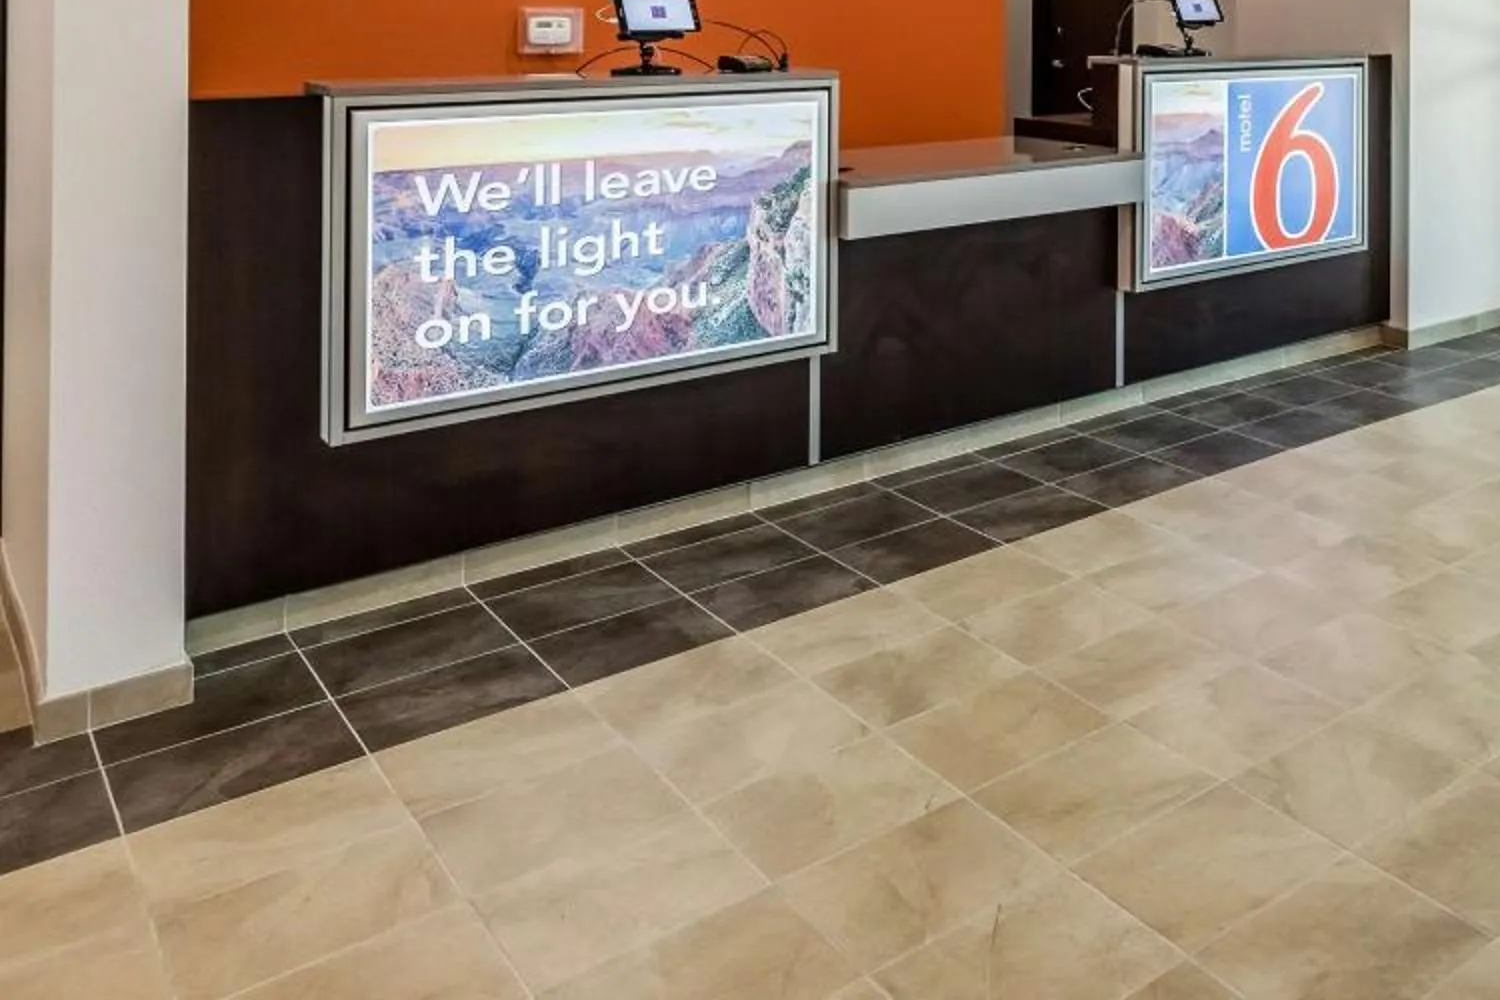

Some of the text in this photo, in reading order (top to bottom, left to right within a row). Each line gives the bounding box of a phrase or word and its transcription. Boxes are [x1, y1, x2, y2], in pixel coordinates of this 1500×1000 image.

[414, 160, 718, 217] We'll leave
[1237, 81, 1340, 252] motel 6
[414, 219, 665, 284] the light
[414, 282, 722, 350] on for you.
